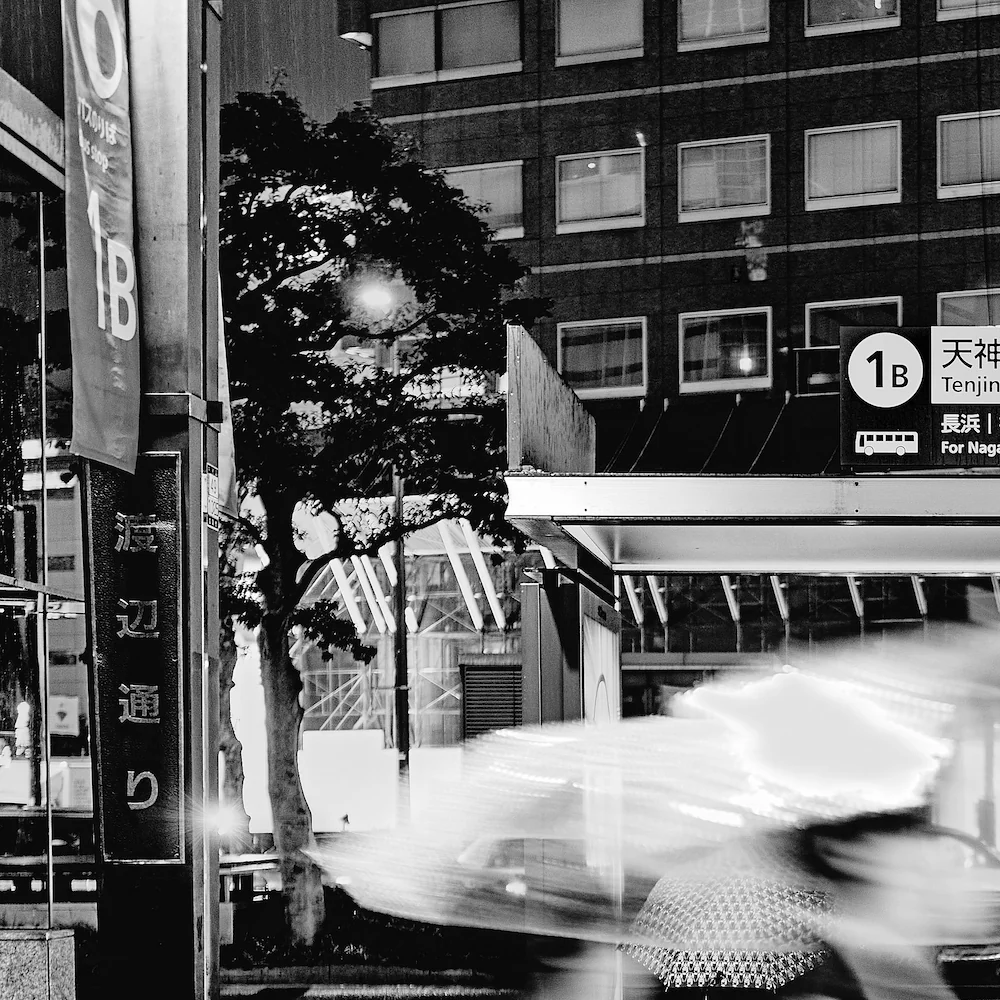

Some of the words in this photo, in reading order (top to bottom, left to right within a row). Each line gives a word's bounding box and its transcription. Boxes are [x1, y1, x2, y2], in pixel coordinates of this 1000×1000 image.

[86, 189, 137, 342] 1B
[866, 350, 909, 388] 1B
[941, 376, 1000, 396] Tenjin
[940, 413, 981, 434] 長浜
[941, 441, 965, 454] For
[114, 512, 160, 810] 渡辺通り
